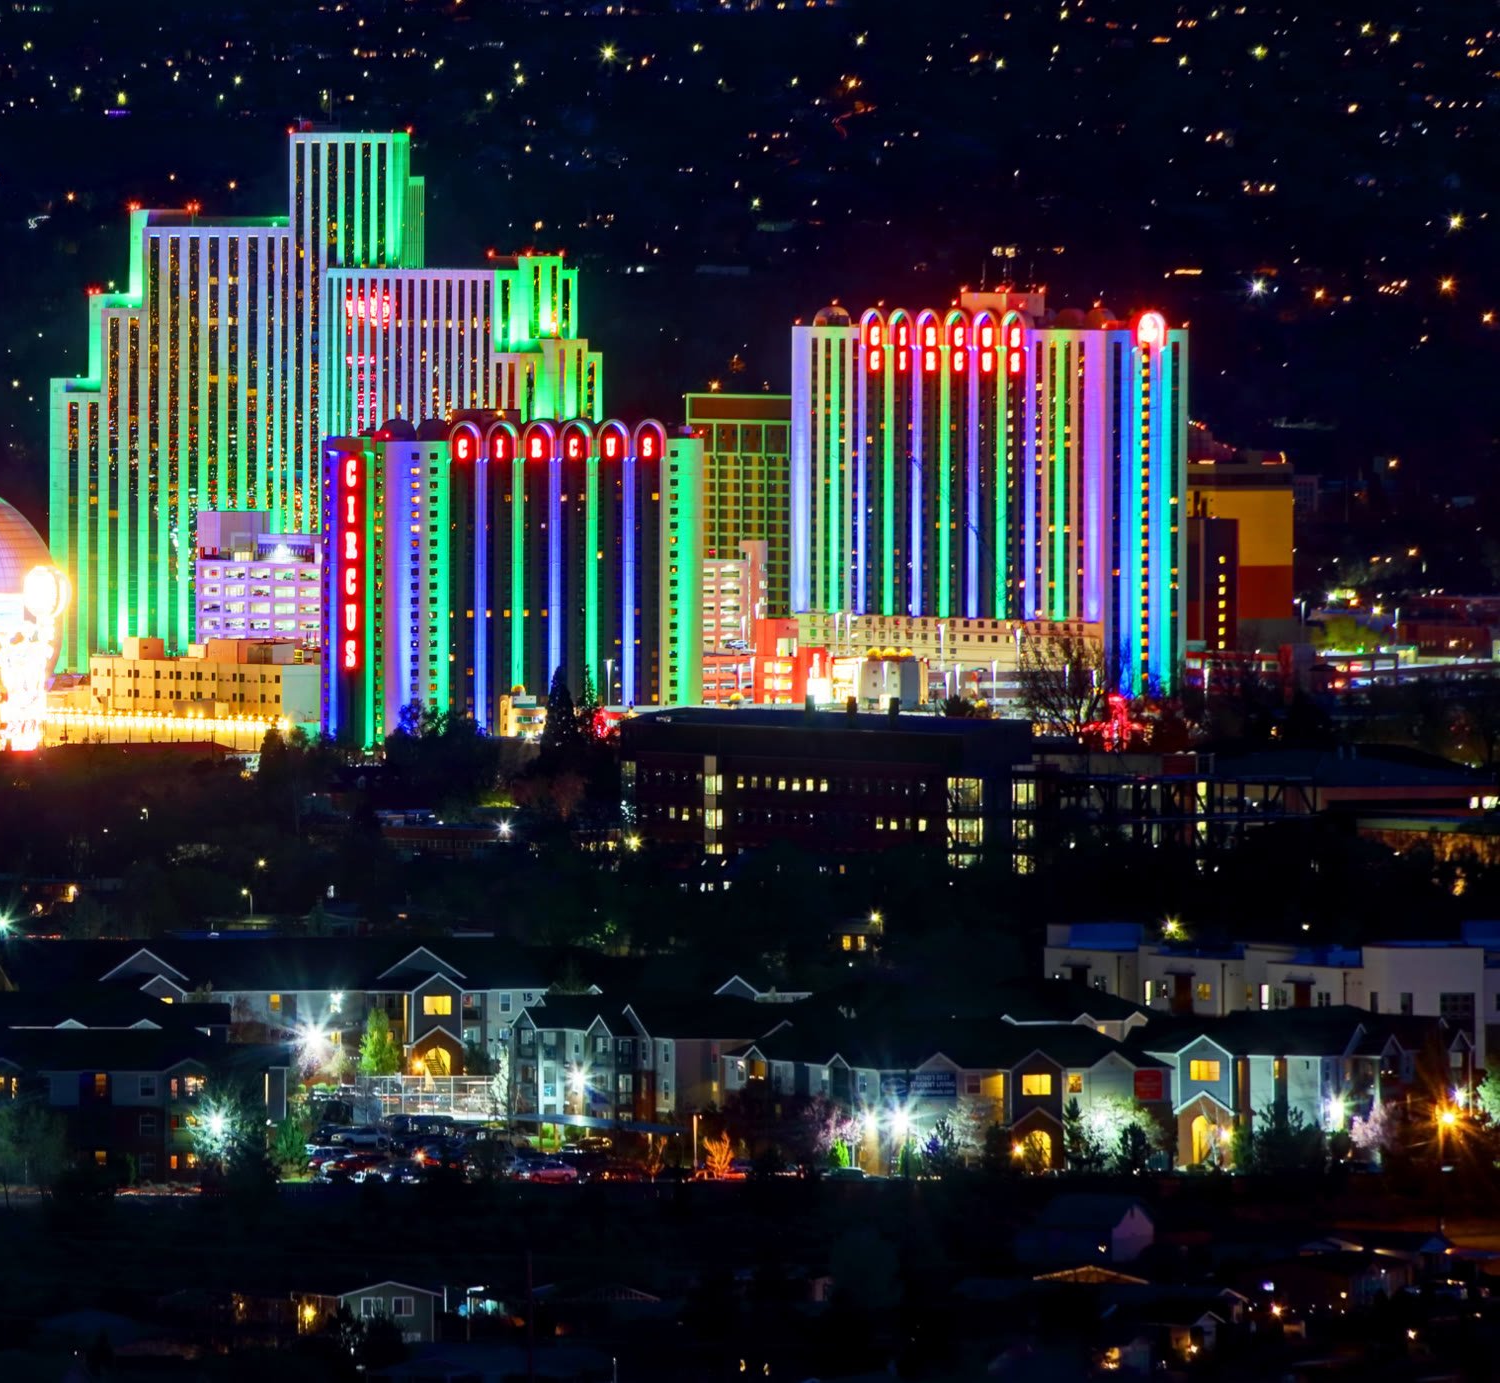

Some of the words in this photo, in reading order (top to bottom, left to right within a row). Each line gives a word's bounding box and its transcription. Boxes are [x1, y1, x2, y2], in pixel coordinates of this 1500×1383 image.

[870, 325, 1021, 348] CIRCUS
[870, 350, 1020, 373] CIRCUS
[457, 437, 652, 459] CIRCUS
[345, 459, 358, 668] CIRCUS
[910, 1081, 935, 1089] STUDENT
